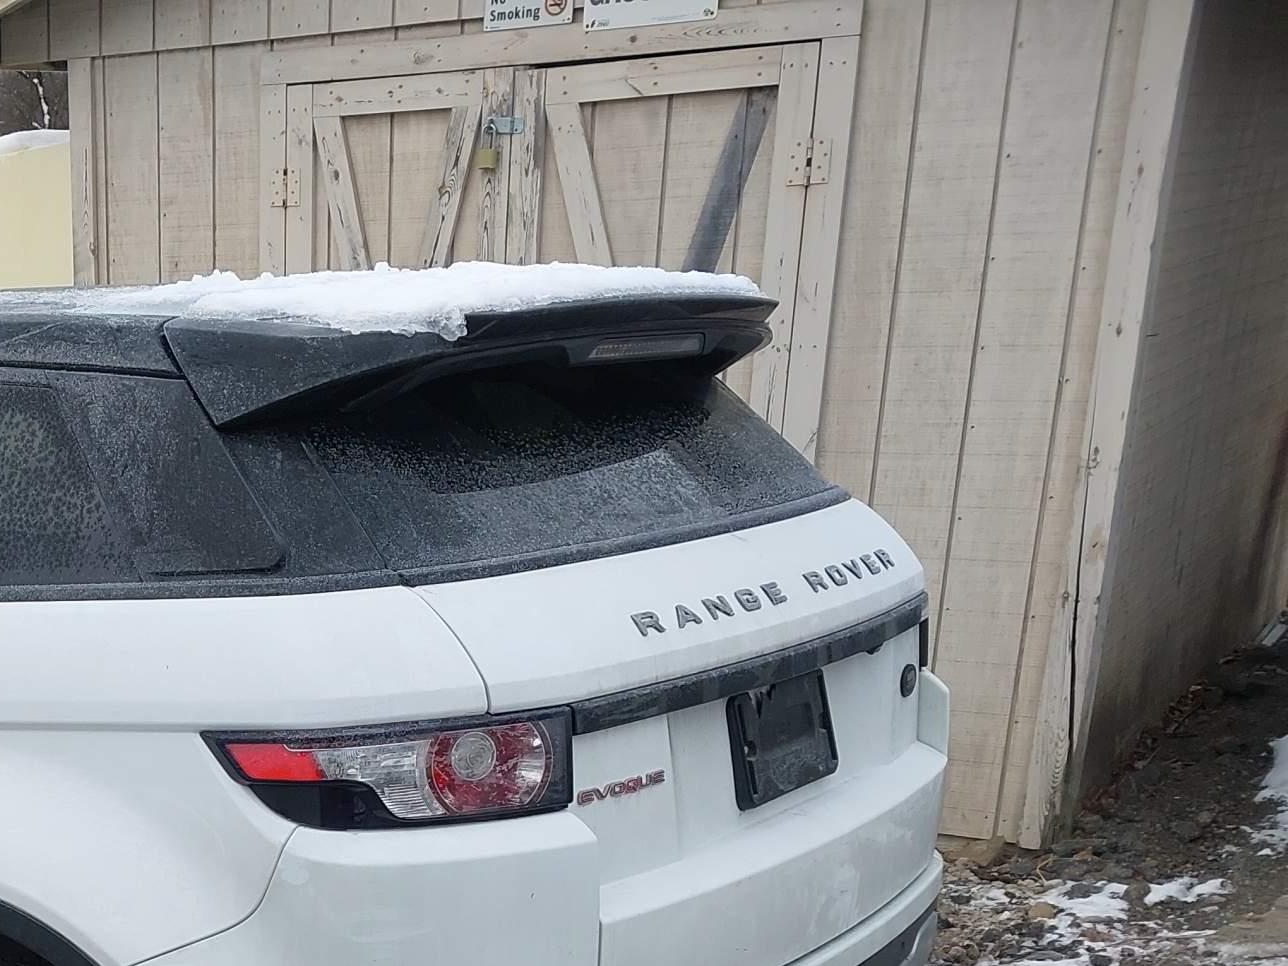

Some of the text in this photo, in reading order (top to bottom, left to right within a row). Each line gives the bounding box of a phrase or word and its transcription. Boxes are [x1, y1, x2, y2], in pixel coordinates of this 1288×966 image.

[490, 6, 540, 21] Smoking
[630, 549, 895, 637] RANGE ROVER
[577, 768, 665, 806] EVOQUE
